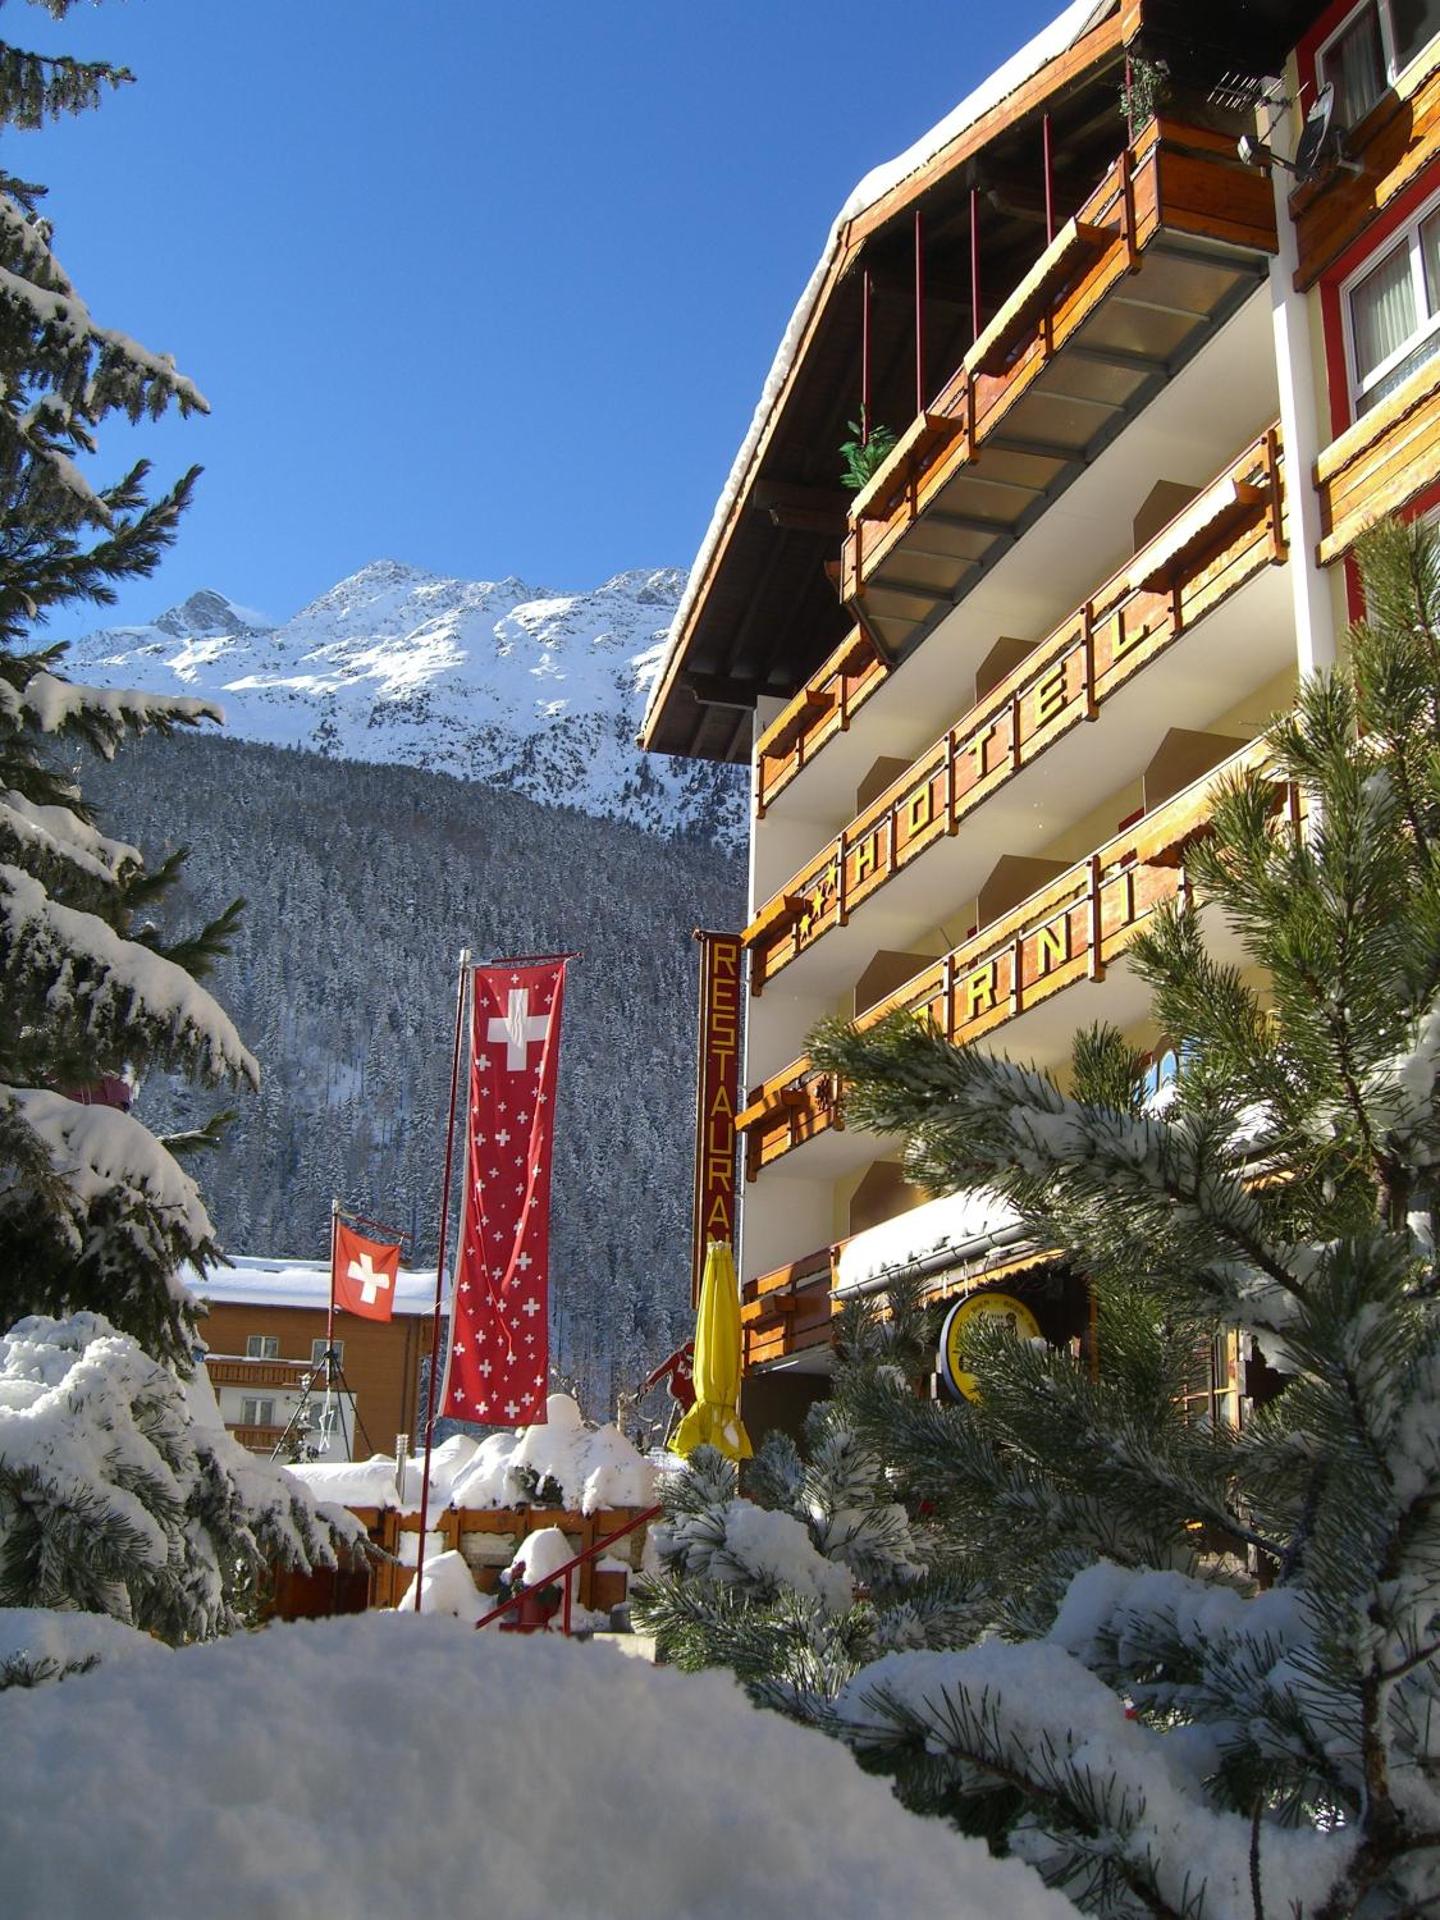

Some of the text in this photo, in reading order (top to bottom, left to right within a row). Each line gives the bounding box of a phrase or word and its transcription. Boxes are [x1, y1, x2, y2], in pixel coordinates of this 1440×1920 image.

[855, 609, 1149, 883] HOTEL
[911, 871, 1131, 1034] RNI
[706, 942, 737, 1242] RESTAURA
